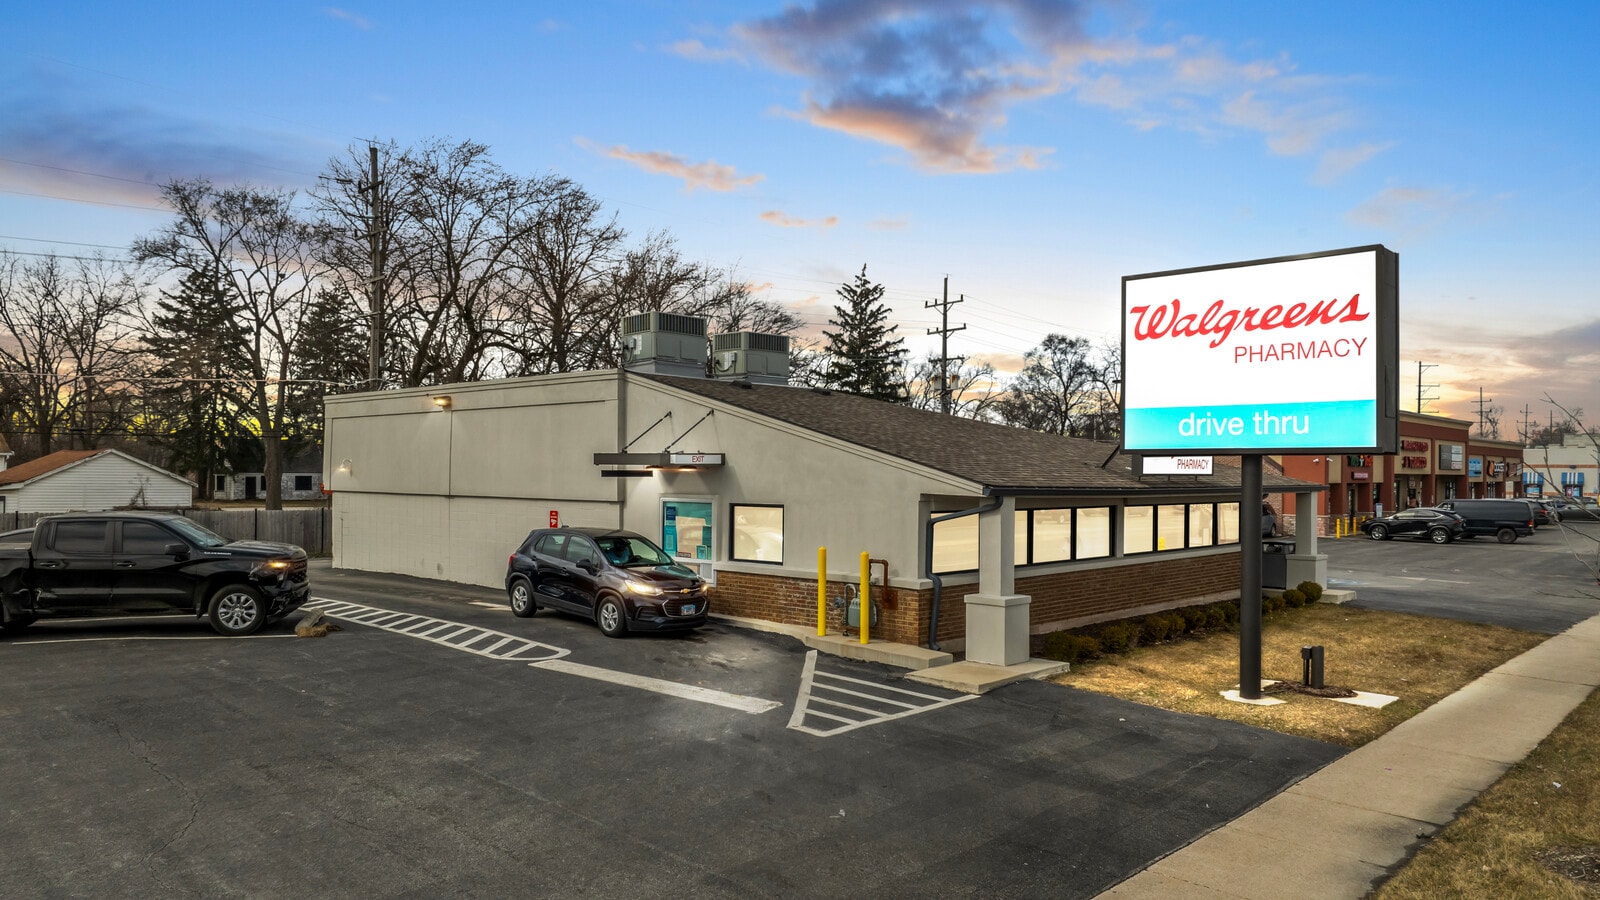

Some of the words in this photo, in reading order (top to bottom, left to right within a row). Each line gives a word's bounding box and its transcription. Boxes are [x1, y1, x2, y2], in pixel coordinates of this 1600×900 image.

[1130, 293, 1370, 348] Walgreens
[1234, 337, 1368, 363] PHARMACY
[1179, 412, 1244, 437] drive
[1252, 410, 1309, 435] thru
[691, 455, 704, 463] EXIT
[1177, 458, 1209, 470] PHARMACY
